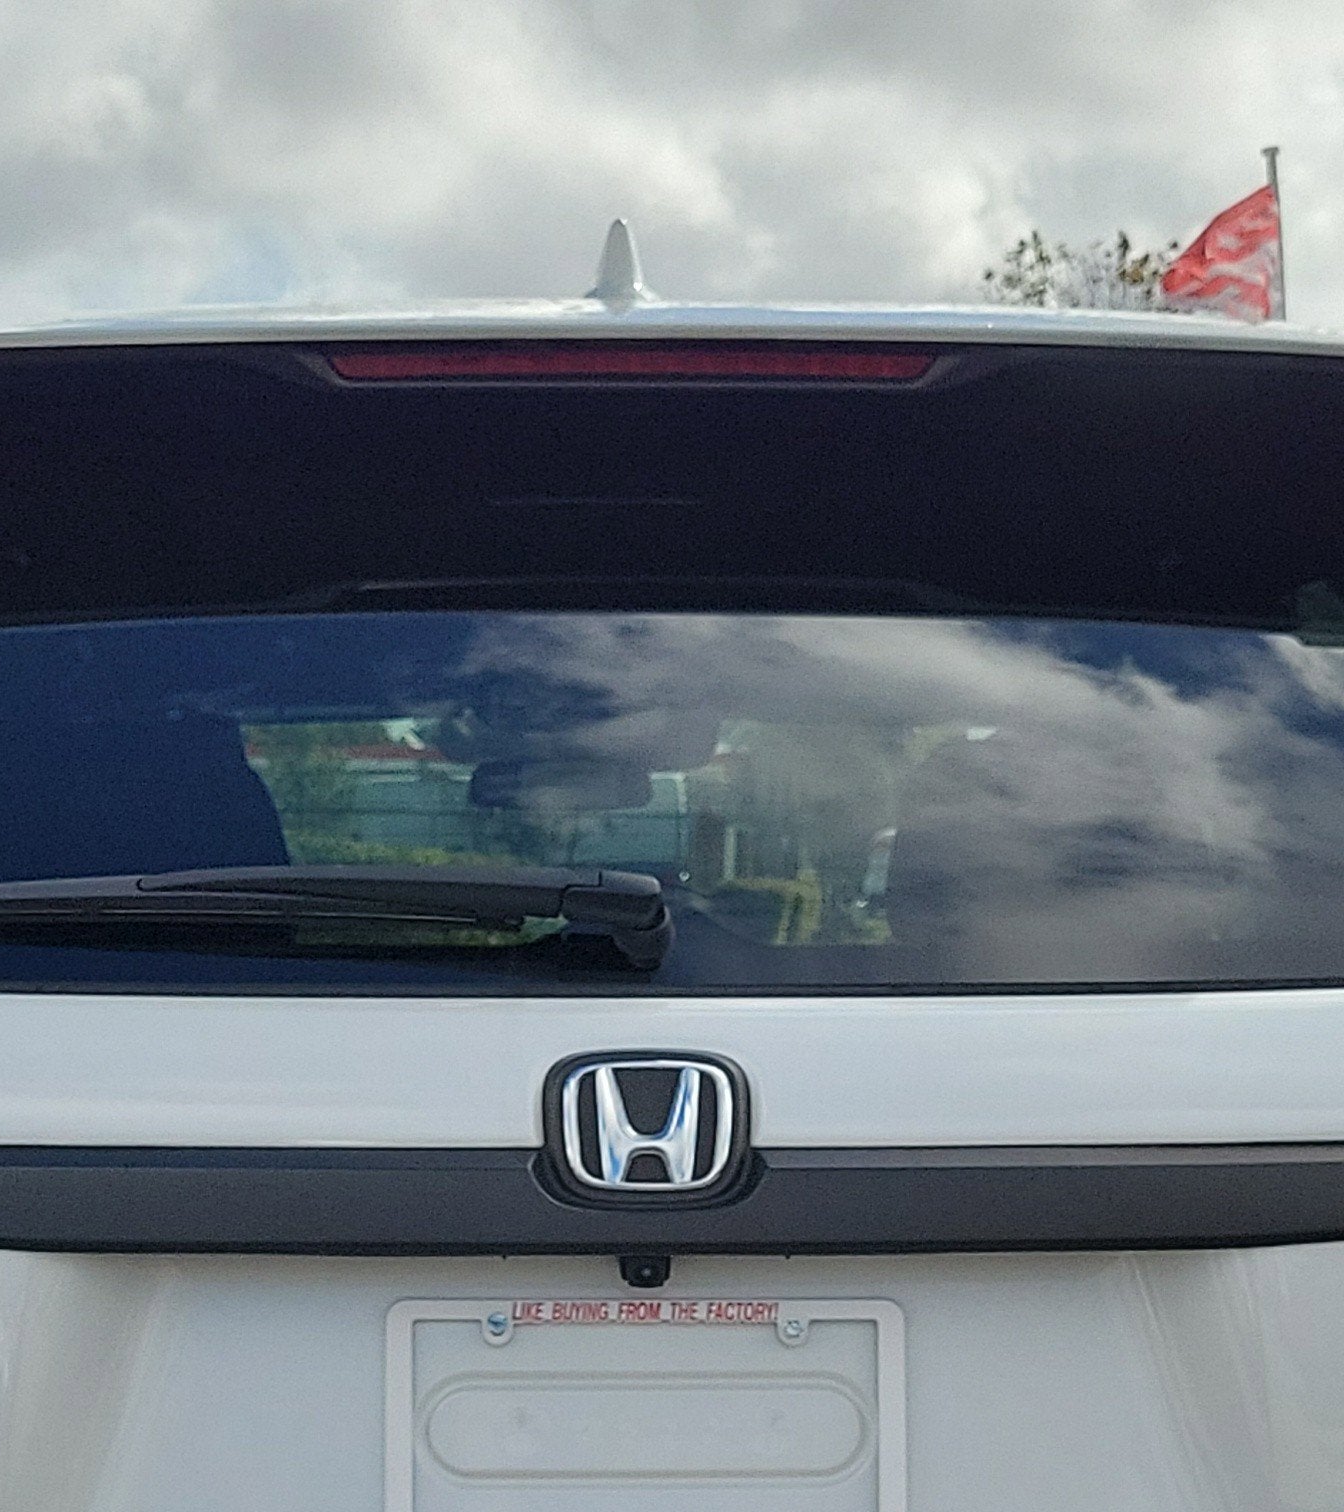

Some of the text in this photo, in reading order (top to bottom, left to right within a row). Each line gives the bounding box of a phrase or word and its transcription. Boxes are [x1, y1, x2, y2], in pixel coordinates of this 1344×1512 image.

[512, 1302, 780, 1321] LIKE BUYING FROM THE FACTORY!
